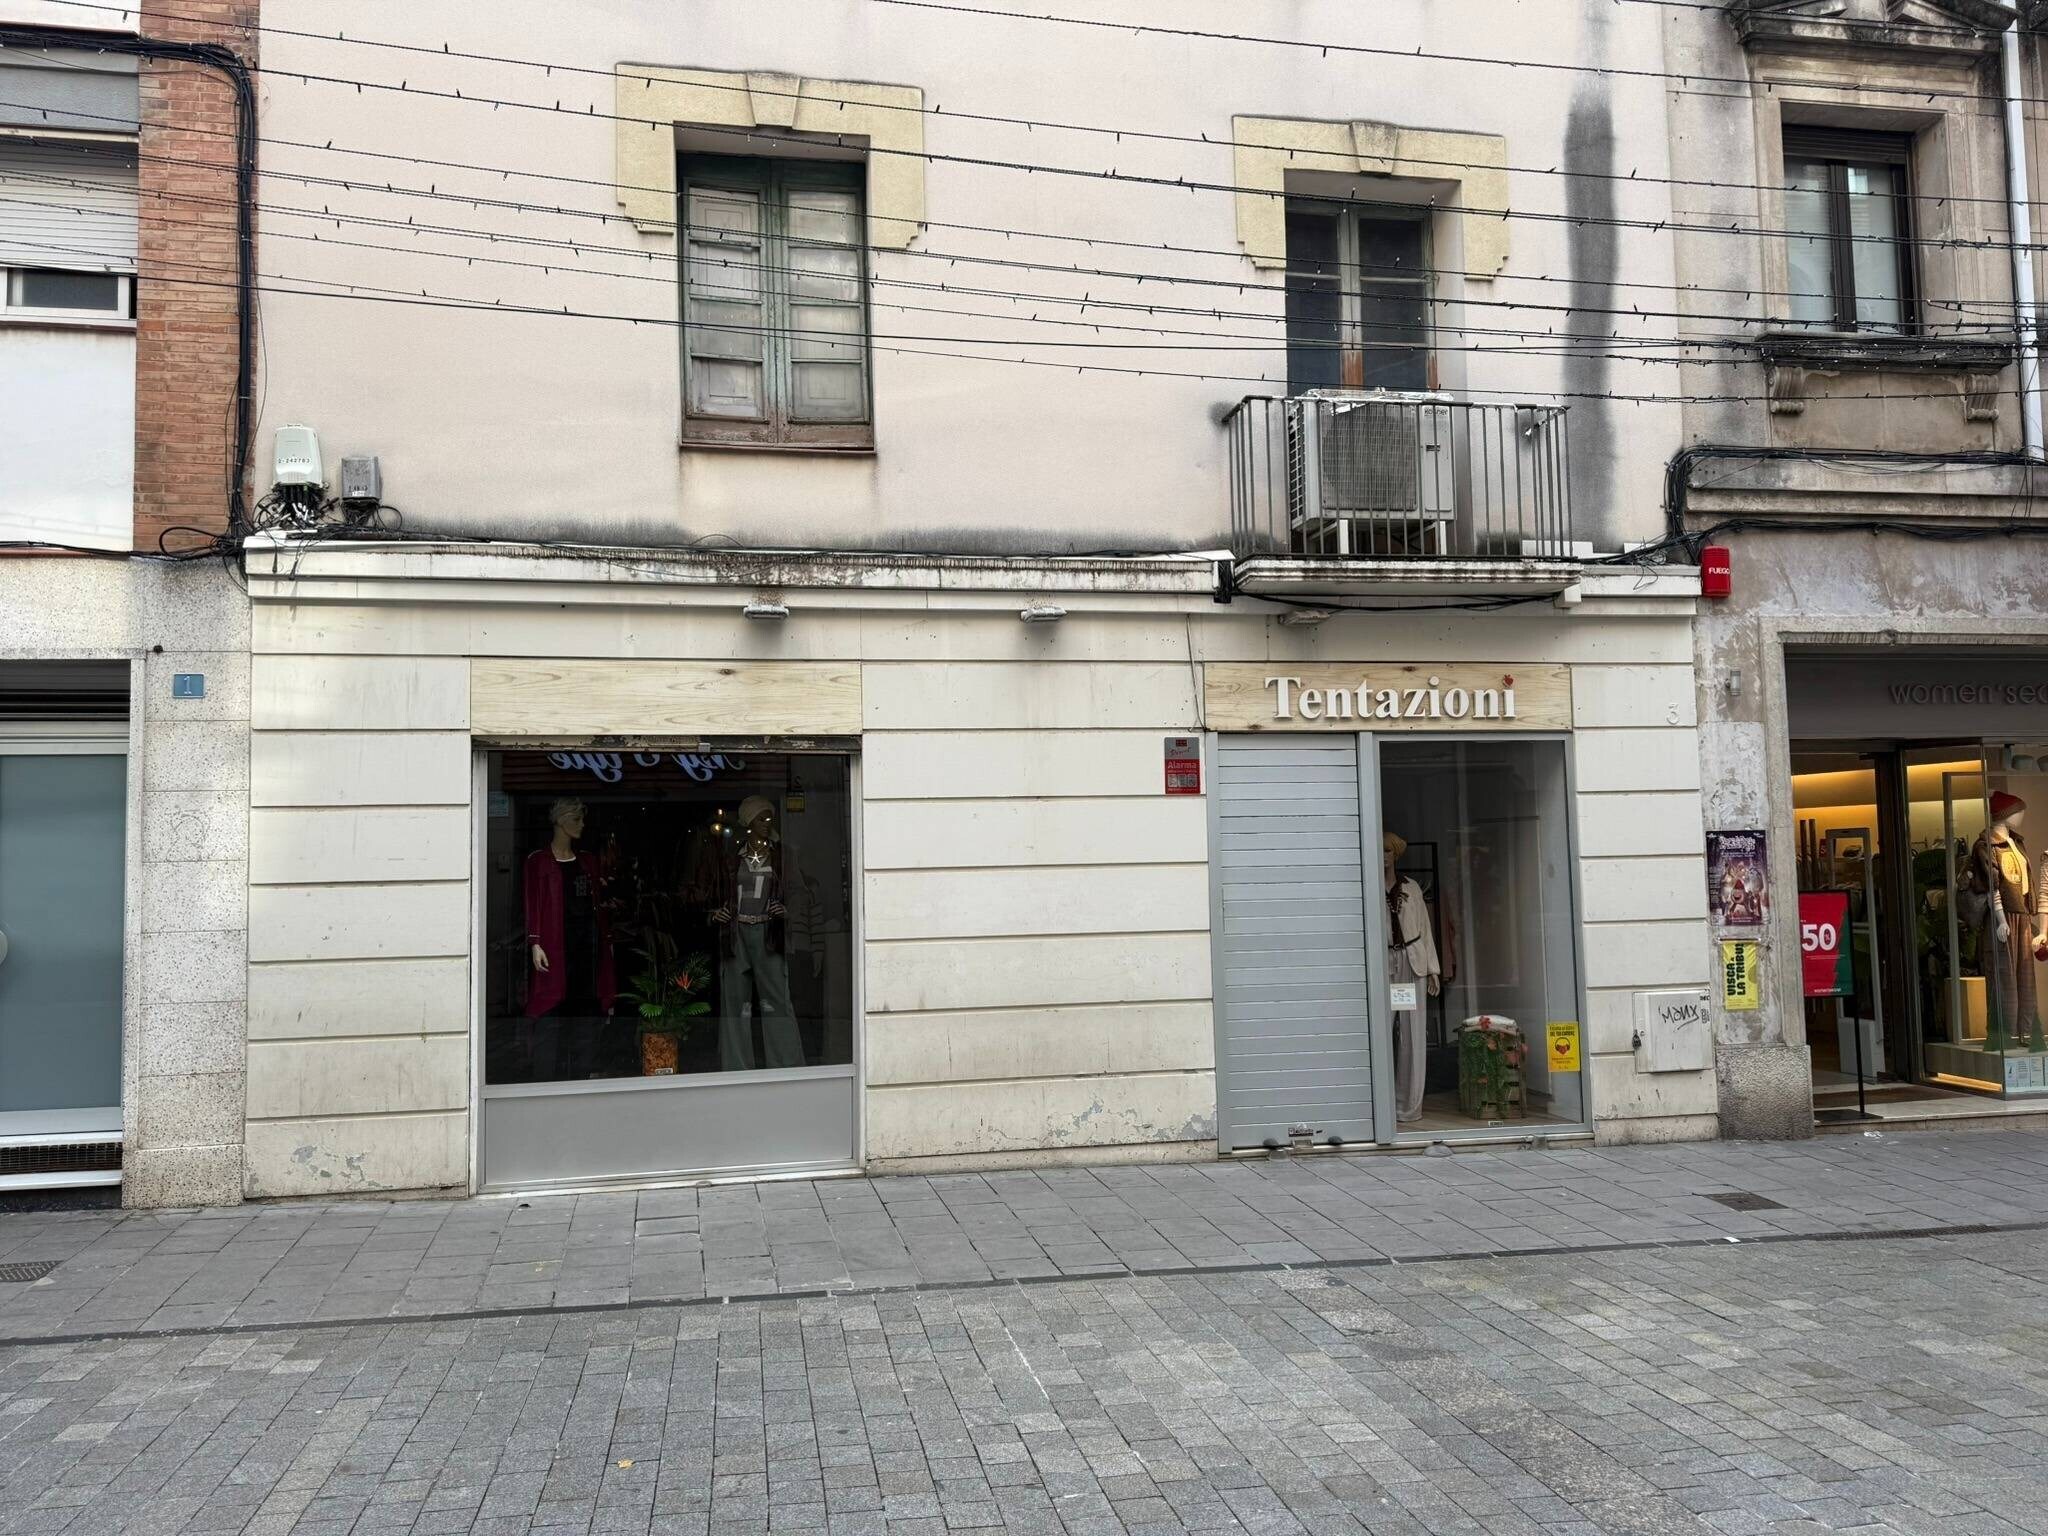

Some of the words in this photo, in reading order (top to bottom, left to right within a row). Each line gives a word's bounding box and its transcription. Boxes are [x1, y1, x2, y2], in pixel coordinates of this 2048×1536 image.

[1708, 567, 1730, 575] FUEGO
[1264, 674, 1517, 719] Tentazioni
[1666, 703, 1680, 725] 3
[1167, 761, 1197, 769] Alarma
[1736, 982, 1746, 996] LA
